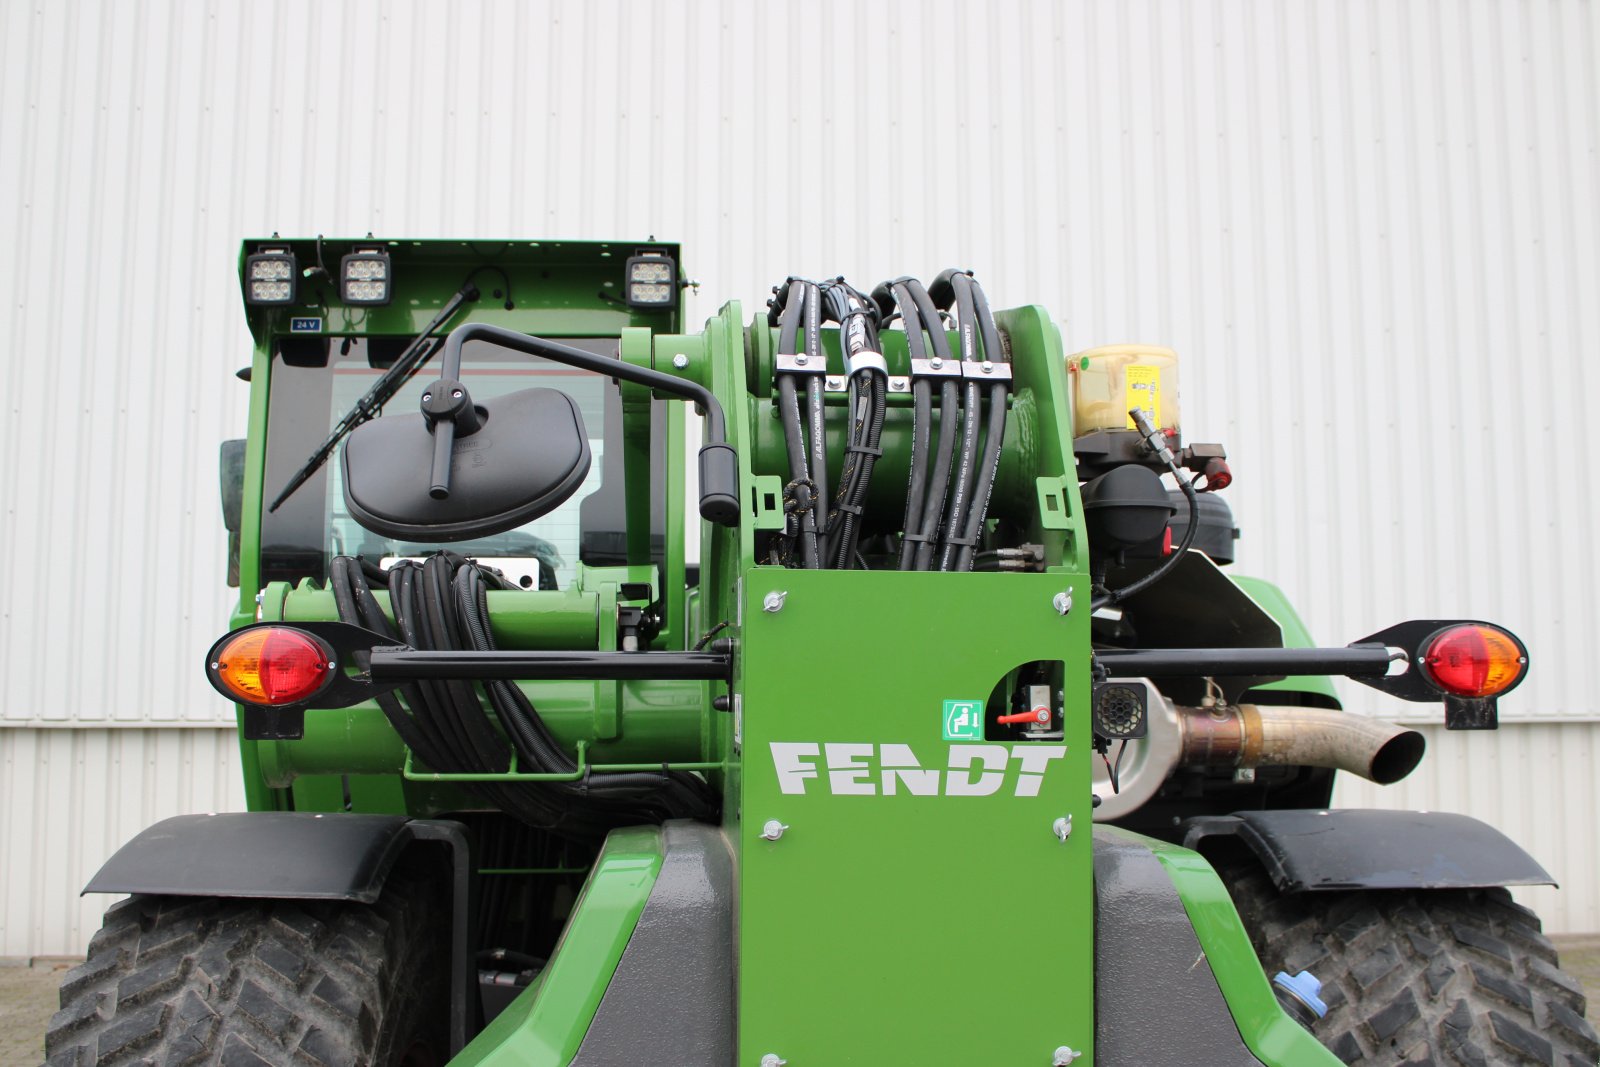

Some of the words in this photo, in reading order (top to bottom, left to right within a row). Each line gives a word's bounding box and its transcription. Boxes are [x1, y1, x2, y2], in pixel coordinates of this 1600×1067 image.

[297, 320, 307, 329] 24
[309, 320, 316, 329] V
[769, 742, 1067, 796] FENDT
